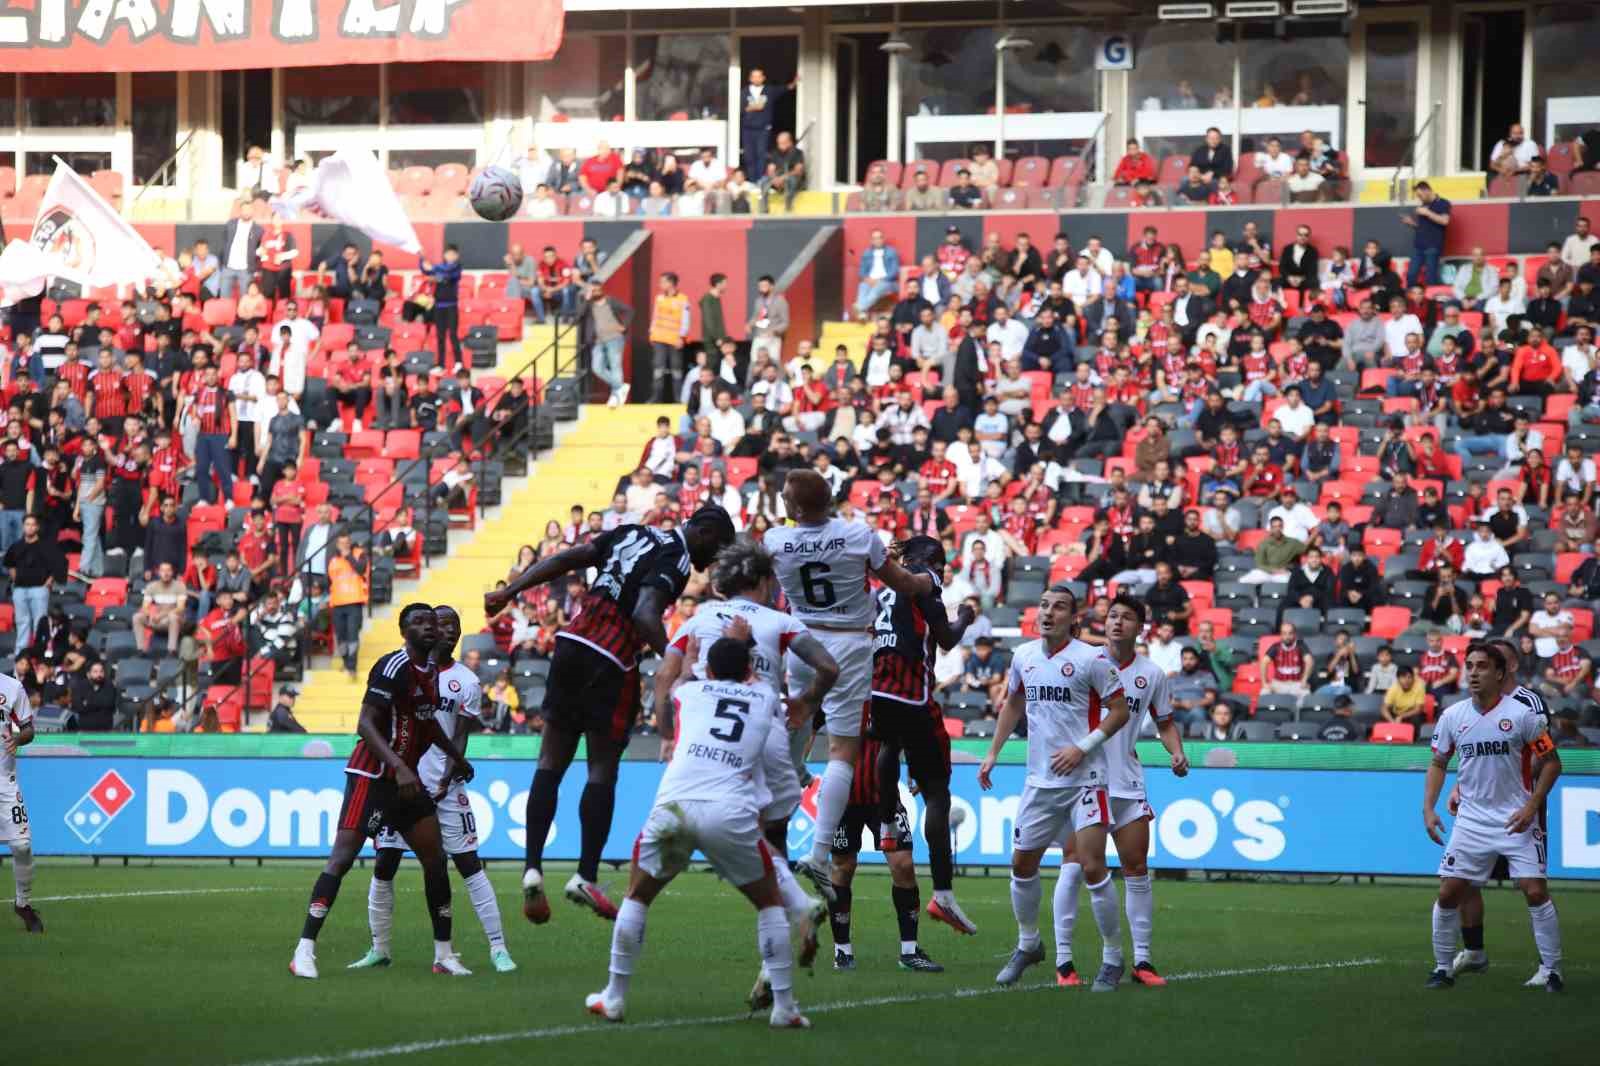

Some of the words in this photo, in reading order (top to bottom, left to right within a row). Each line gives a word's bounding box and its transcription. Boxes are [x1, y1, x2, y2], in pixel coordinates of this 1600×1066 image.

[1103, 36, 1126, 64] G
[783, 538, 846, 553] BALKAR
[800, 561, 837, 609] 6
[1039, 686, 1072, 703] ARCA
[709, 698, 751, 743] 5
[1476, 741, 1510, 757] ARCA
[11, 805, 29, 825] 89
[459, 811, 477, 835] 10
